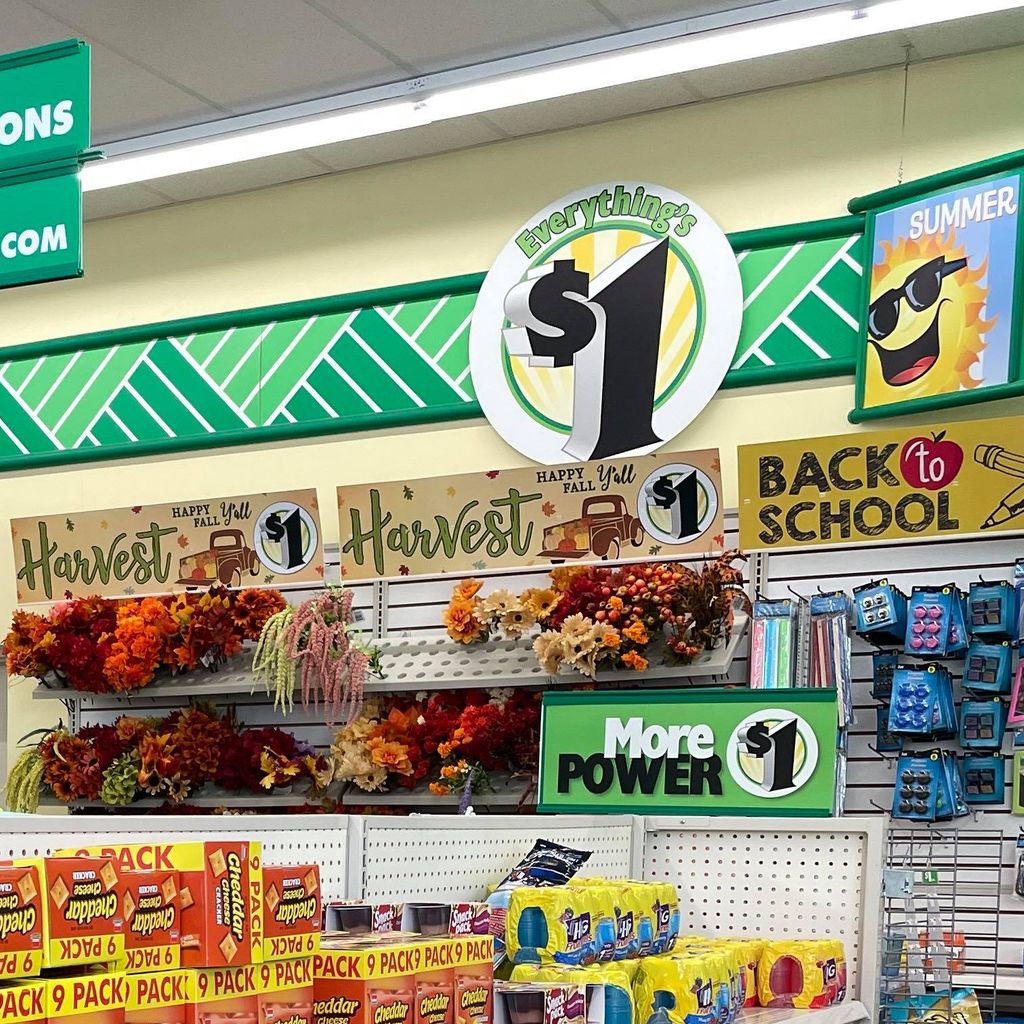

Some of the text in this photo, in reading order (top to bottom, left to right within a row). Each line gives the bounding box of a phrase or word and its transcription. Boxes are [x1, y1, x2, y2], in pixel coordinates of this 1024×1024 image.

[515, 186, 697, 258] Everything's
[910, 186, 1018, 239] SUMMER
[501, 236, 670, 462] $1
[536, 468, 584, 483] HAPPY
[563, 481, 596, 493] FALL
[597, 464, 636, 491] Y'all
[759, 441, 946, 498] BACK to
[172, 504, 210, 518] HAPPY
[194, 516, 220, 527] FALL
[220, 502, 251, 526] Y'all
[645, 470, 702, 540] $1
[759, 491, 959, 544] SCHOOL
[260, 507, 306, 570] $1
[342, 488, 542, 575] Harvest
[17, 522, 178, 599] Harvest
[604, 717, 714, 759] More
[737, 718, 798, 792] $1
[558, 754, 723, 796] POWER
[52, 978, 124, 1012] 9 PACK
[199, 967, 256, 997] 9 PACK
